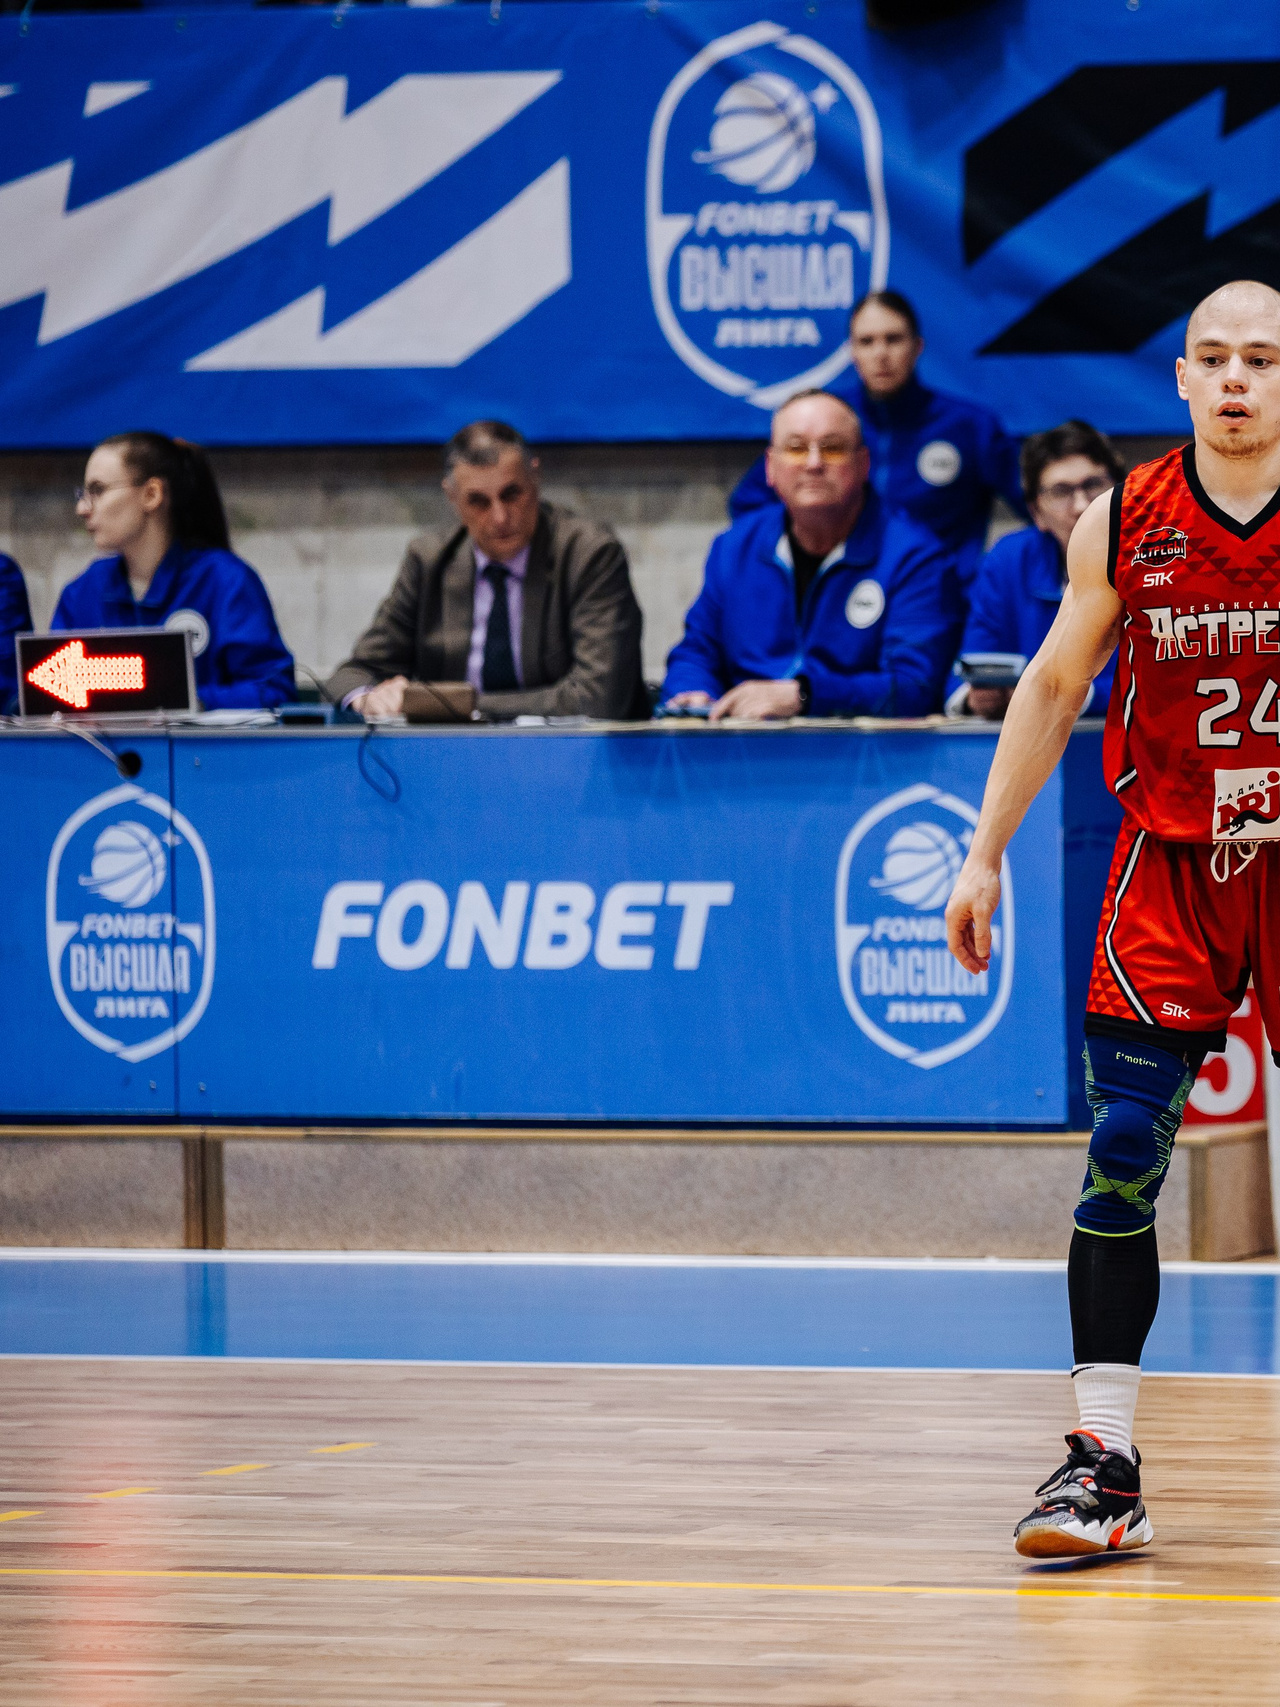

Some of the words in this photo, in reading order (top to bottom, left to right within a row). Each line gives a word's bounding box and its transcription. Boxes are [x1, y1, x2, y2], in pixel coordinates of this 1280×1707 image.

[696, 201, 839, 236] FONBET
[680, 243, 854, 311] ВЫСШАЯ
[715, 318, 821, 348] ЛИГА
[1142, 571, 1175, 587] STK
[1217, 780, 1265, 803] РАДИО
[81, 912, 180, 939] FONBET
[312, 879, 735, 971] FONBET
[871, 916, 947, 942] FONB
[69, 942, 191, 994] ВЫСШАЯ
[94, 996, 170, 1018] ЛИГА
[885, 1001, 966, 1023] ЛИГА
[1161, 1002, 1190, 1019] STK
